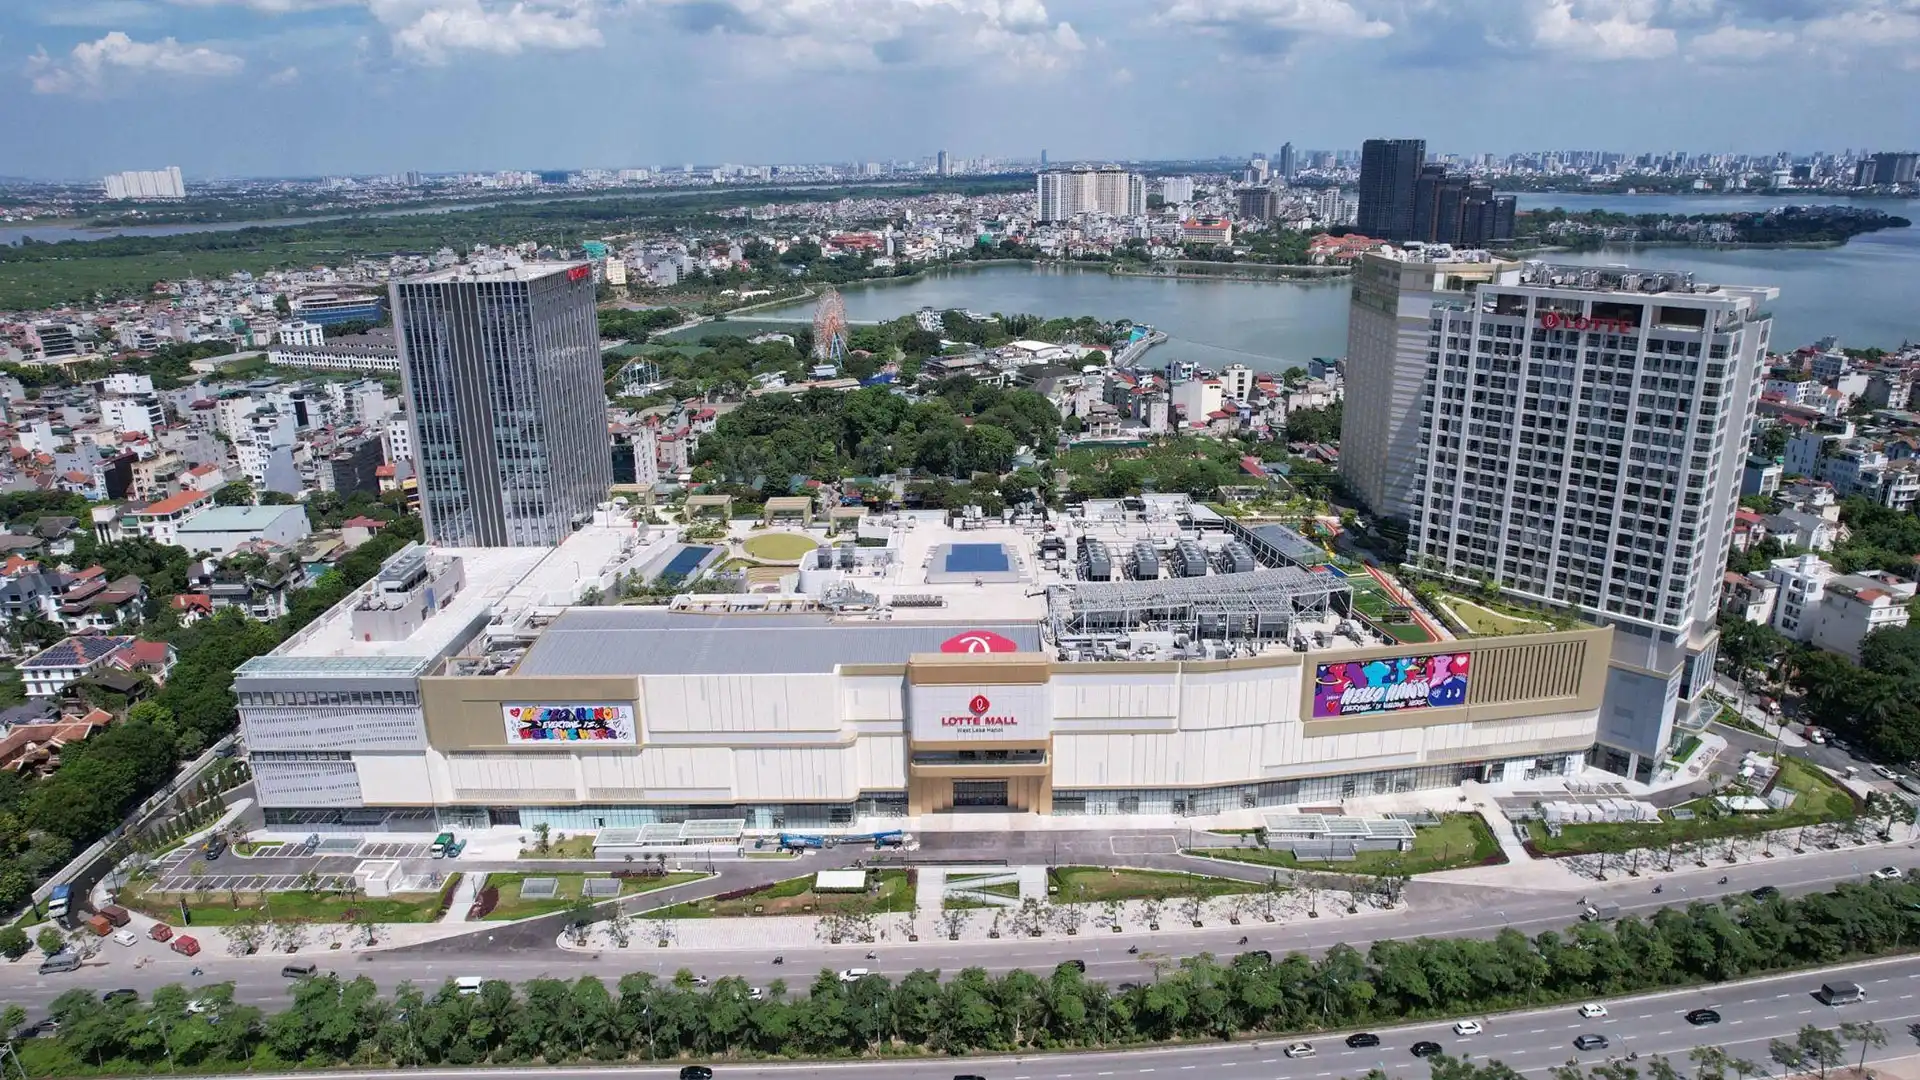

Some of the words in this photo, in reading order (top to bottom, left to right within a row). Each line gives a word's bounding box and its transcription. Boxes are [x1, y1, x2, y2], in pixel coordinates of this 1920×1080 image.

[1564, 317, 1632, 334] LOTTE
[1341, 687, 1385, 704] HELLO
[941, 717, 980, 726] LOTTE
[985, 717, 1017, 725] MALL
